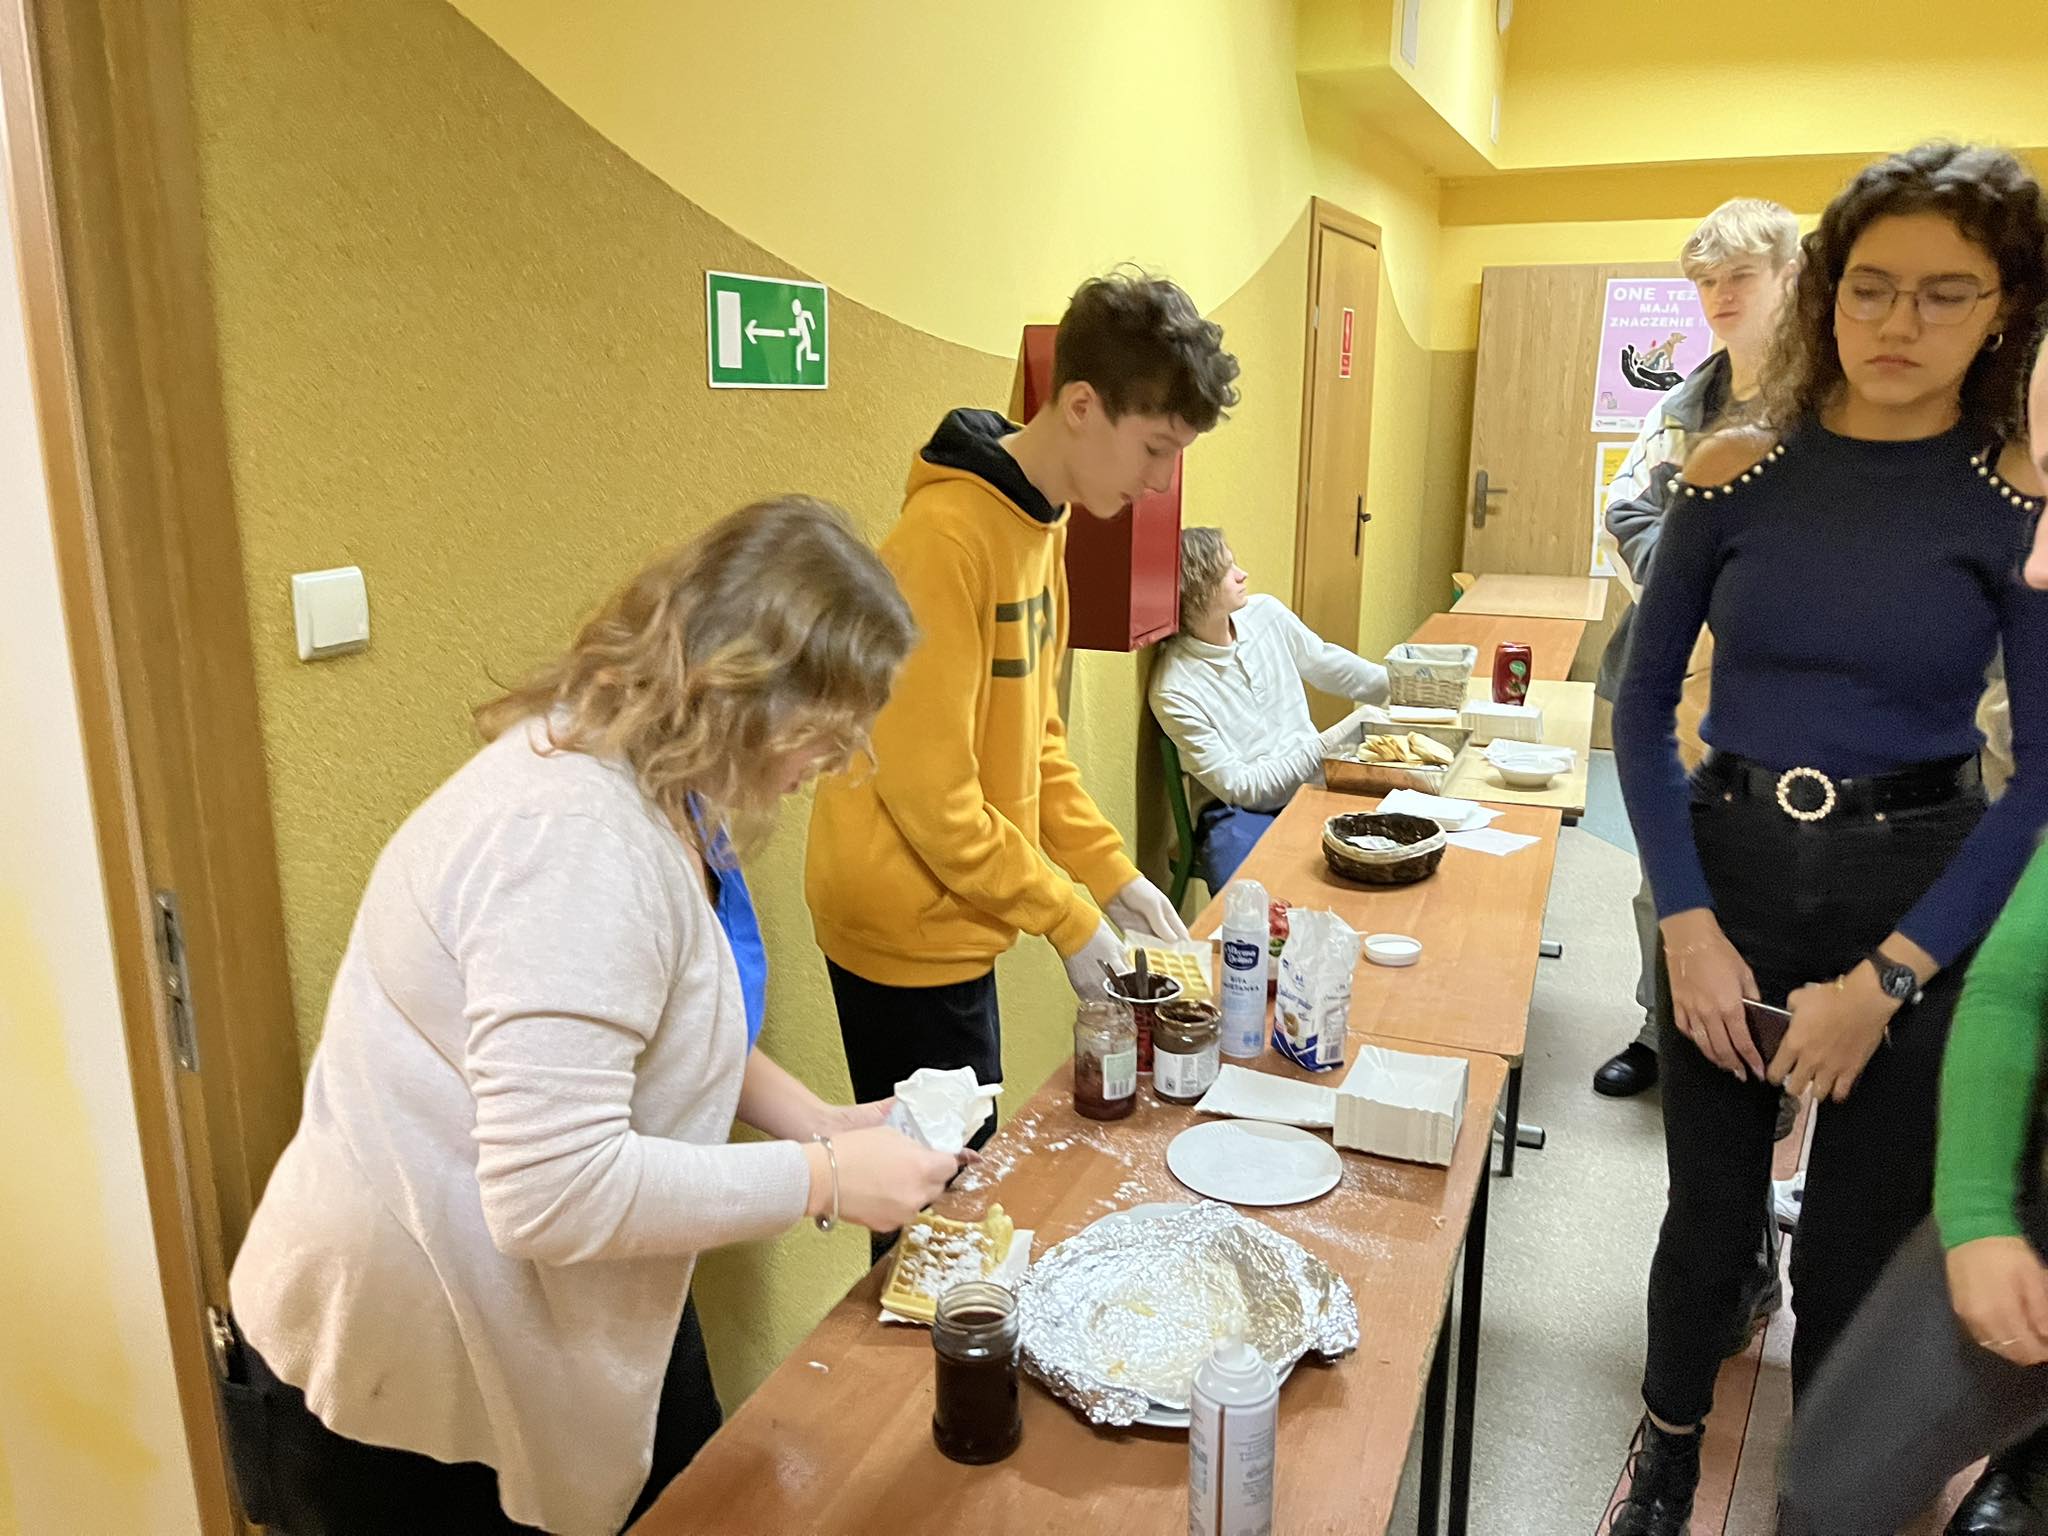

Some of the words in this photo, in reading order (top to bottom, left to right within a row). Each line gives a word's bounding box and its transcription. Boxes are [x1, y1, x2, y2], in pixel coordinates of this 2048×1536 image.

[1613, 287, 1656, 301] ONE
[1639, 303, 1679, 314] MAJĄ
[1610, 316, 1694, 327] ZNACZENIE
